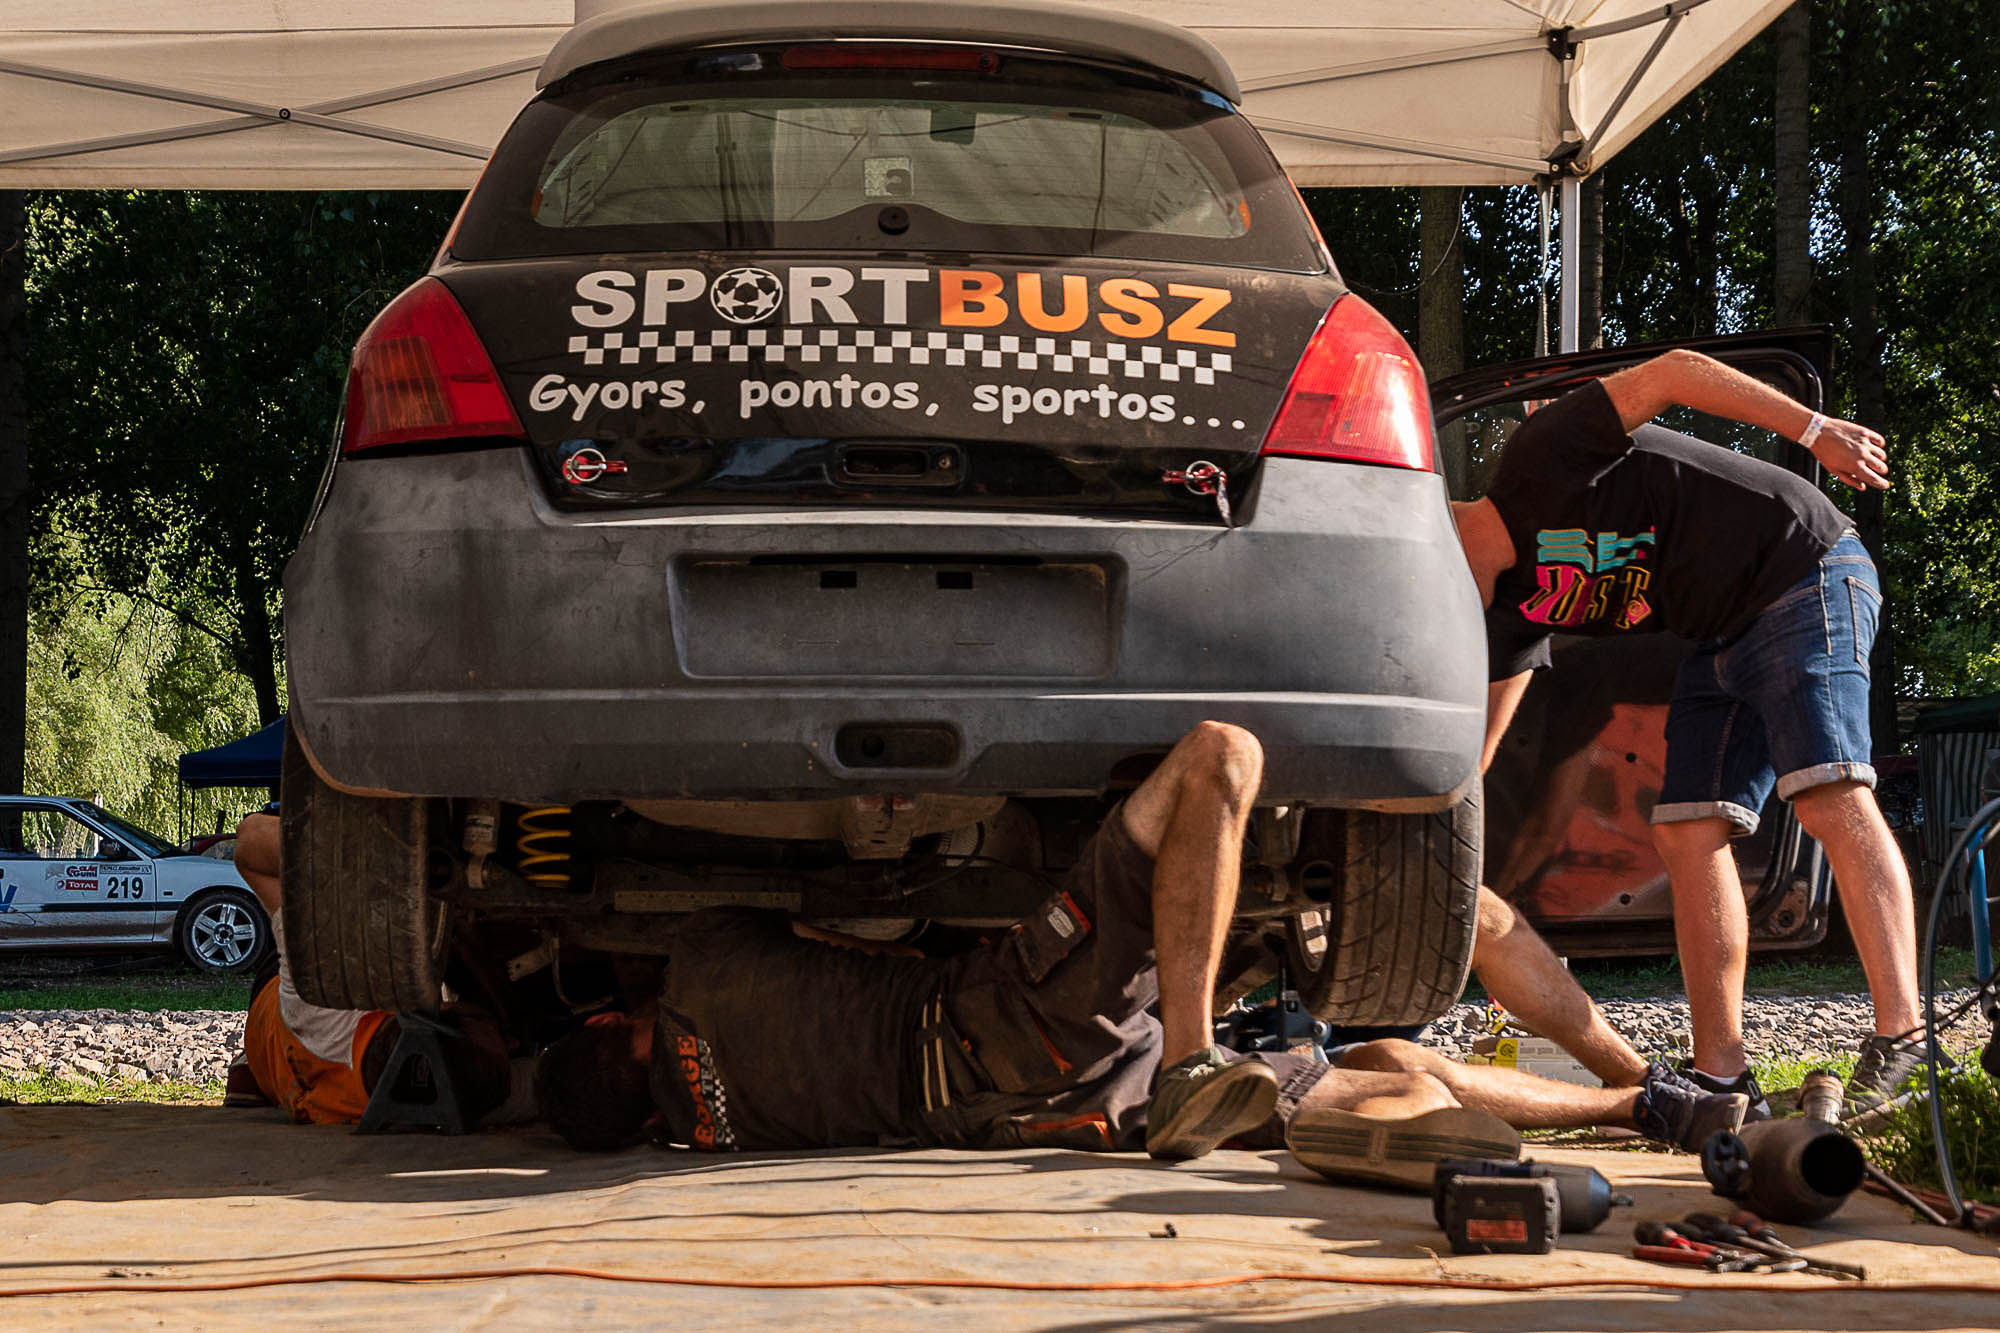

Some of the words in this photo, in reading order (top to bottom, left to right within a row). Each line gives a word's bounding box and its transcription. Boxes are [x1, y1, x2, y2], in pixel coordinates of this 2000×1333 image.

[528, 373, 705, 423] Gyors,
[740, 373, 940, 420] pontos,
[68, 881, 97, 889] TOTAL
[107, 877, 143, 899] 219
